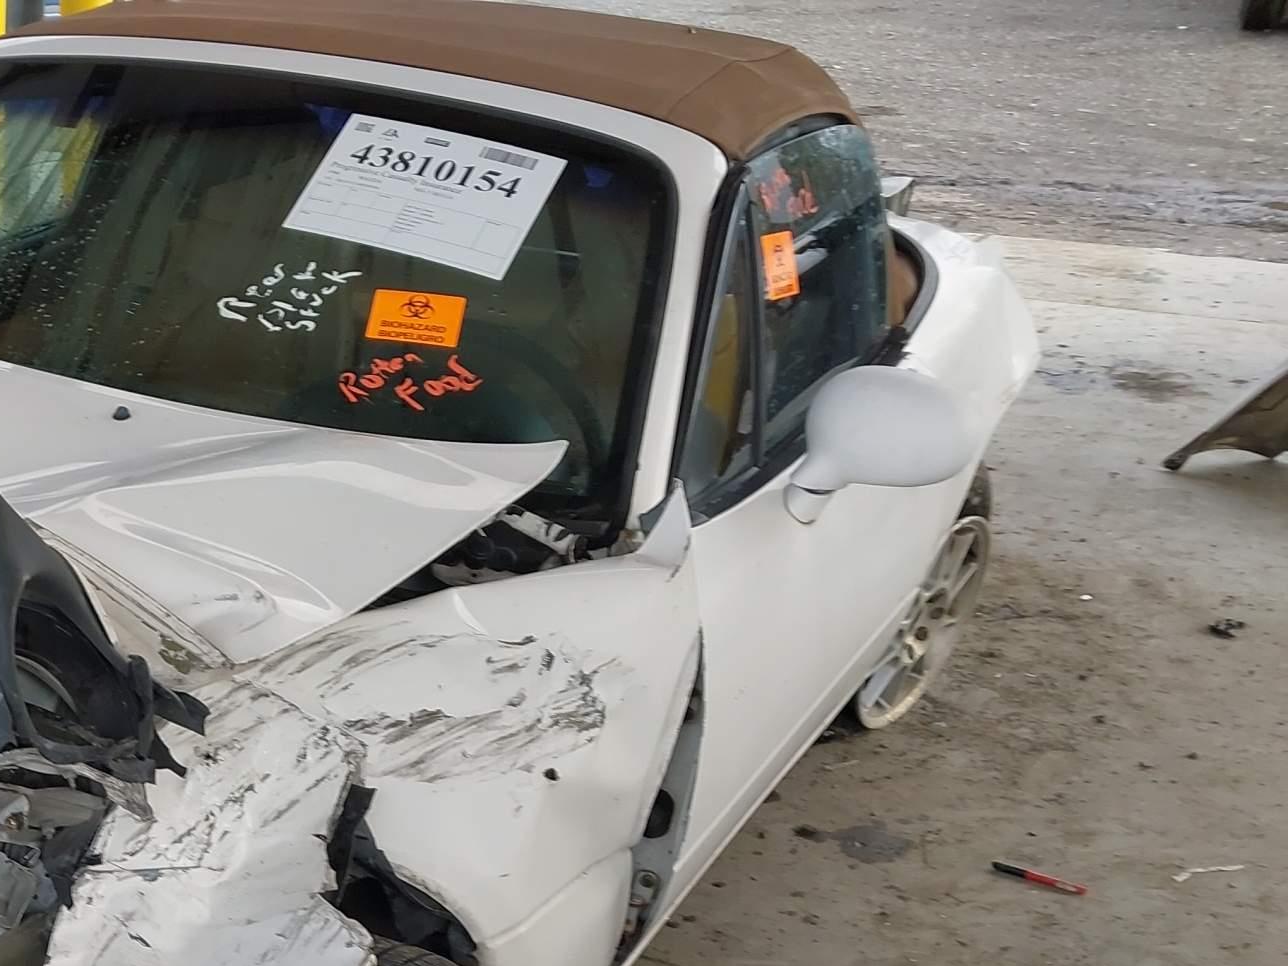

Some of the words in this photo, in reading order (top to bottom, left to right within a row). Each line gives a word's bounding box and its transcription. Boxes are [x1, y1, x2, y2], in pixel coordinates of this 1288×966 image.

[349, 143, 524, 199] 43810154
[216, 263, 286, 322] Rear
[377, 329, 445, 344] BIOPELIGRO
[380, 319, 447, 333] BIOHAZARD
[394, 354, 484, 411] Food
